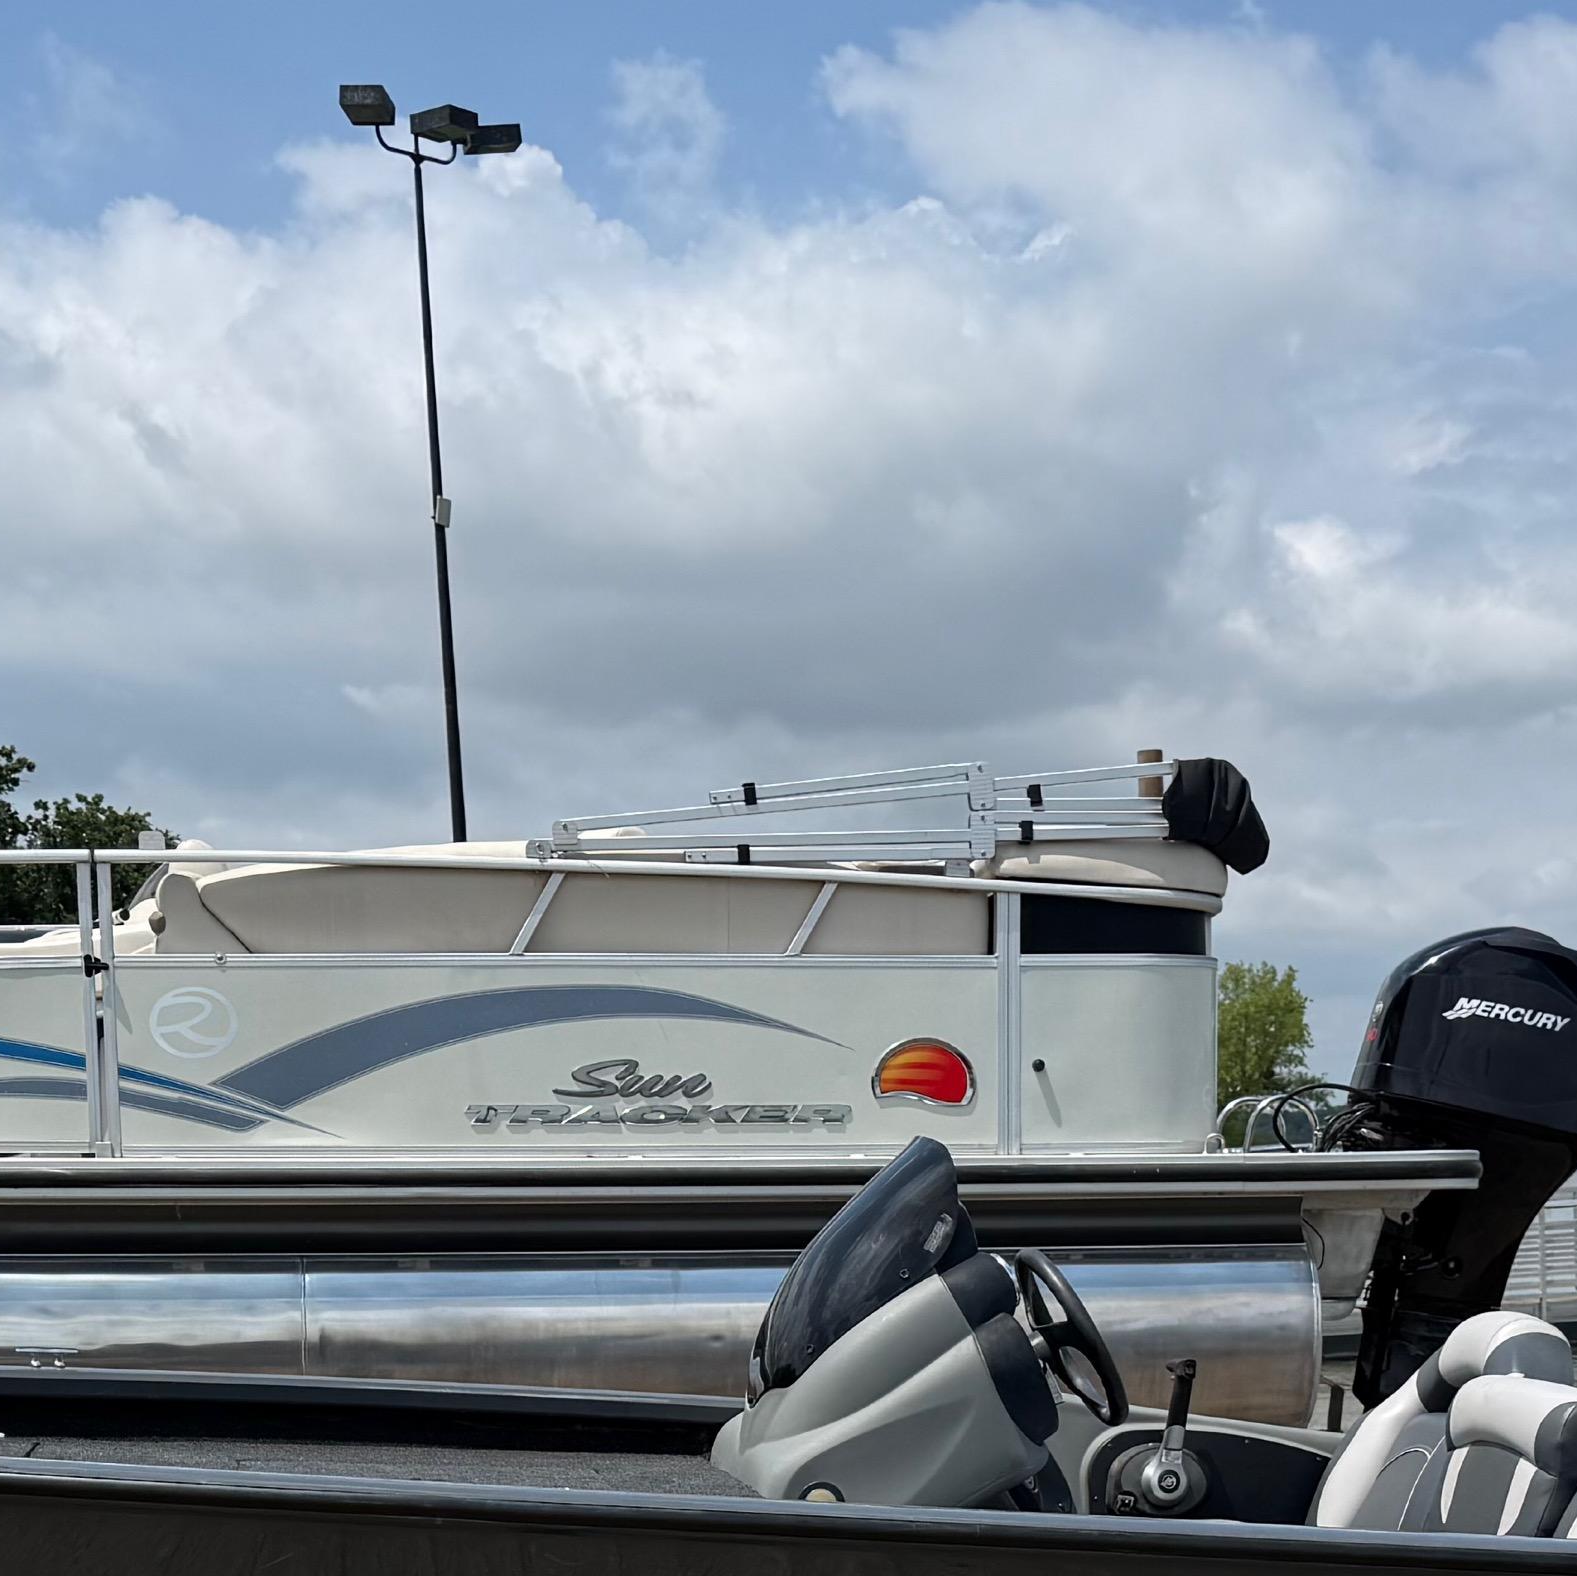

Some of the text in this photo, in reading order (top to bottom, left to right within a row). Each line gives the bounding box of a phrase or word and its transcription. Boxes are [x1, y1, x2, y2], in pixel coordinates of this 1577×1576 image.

[1442, 997, 1571, 1031] MERCURY
[552, 1058, 712, 1098] Sun
[464, 1104, 853, 1126] TRACKER
